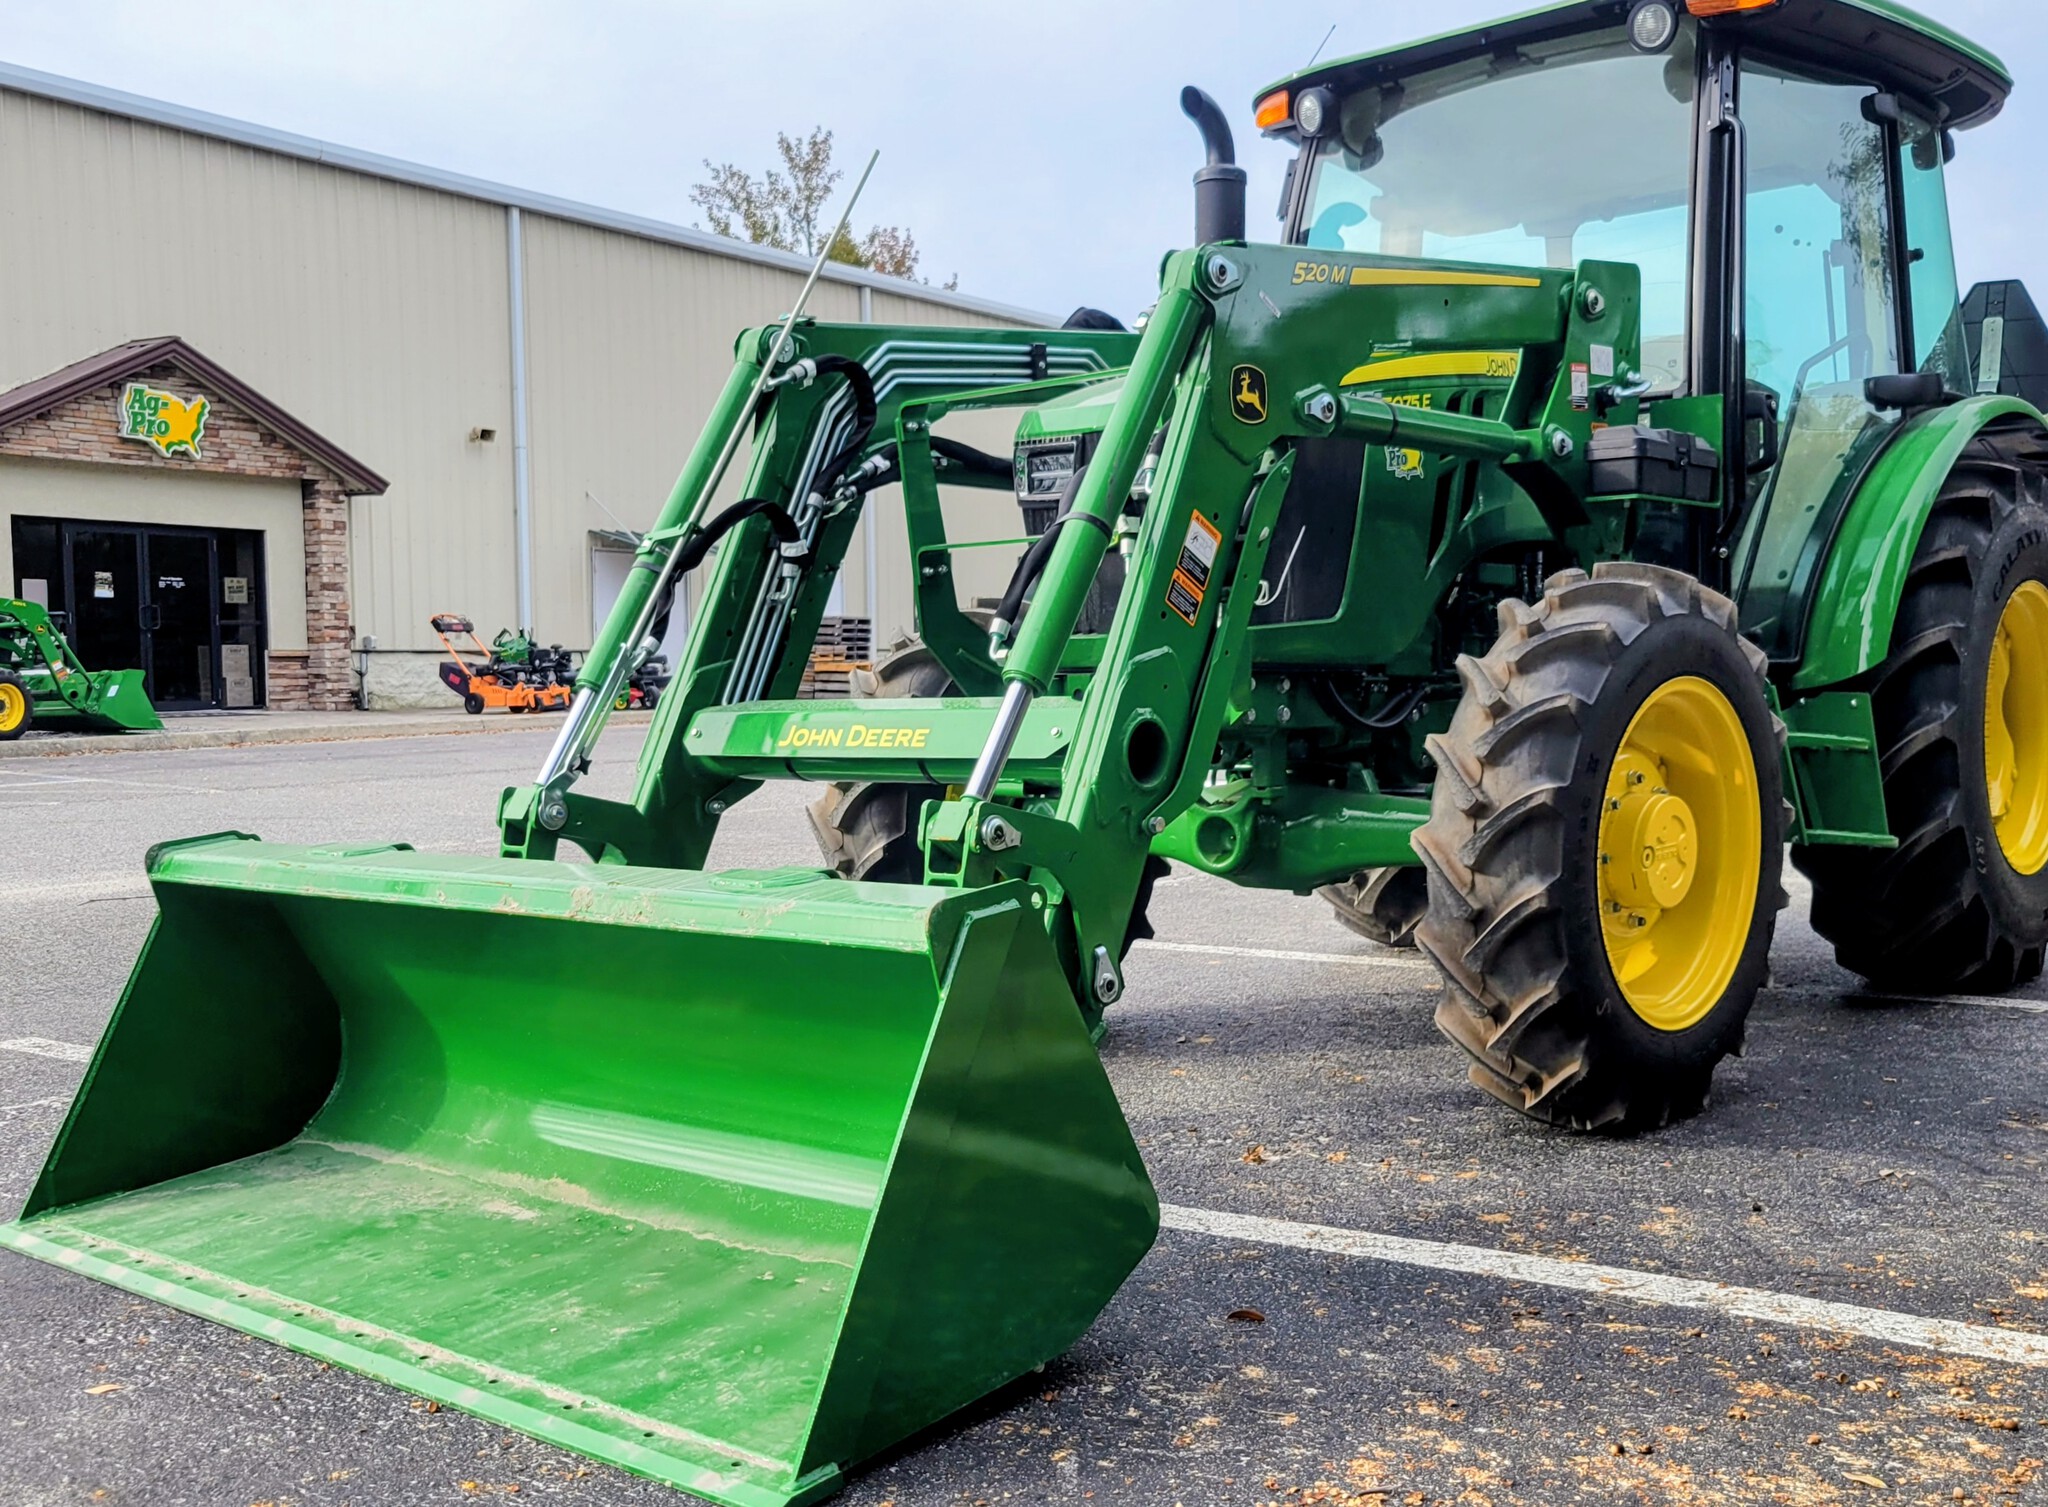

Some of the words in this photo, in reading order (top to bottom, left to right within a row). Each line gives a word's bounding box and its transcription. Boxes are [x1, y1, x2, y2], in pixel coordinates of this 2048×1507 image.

[1292, 261, 1329, 284] 520
[1330, 264, 1347, 284] M
[1486, 355, 1510, 376] JOHN
[129, 388, 169, 417] Ag-
[130, 411, 170, 436] Pro
[1389, 450, 1407, 467] Pro
[778, 725, 844, 748] JOHN
[846, 725, 931, 748] DEERE
